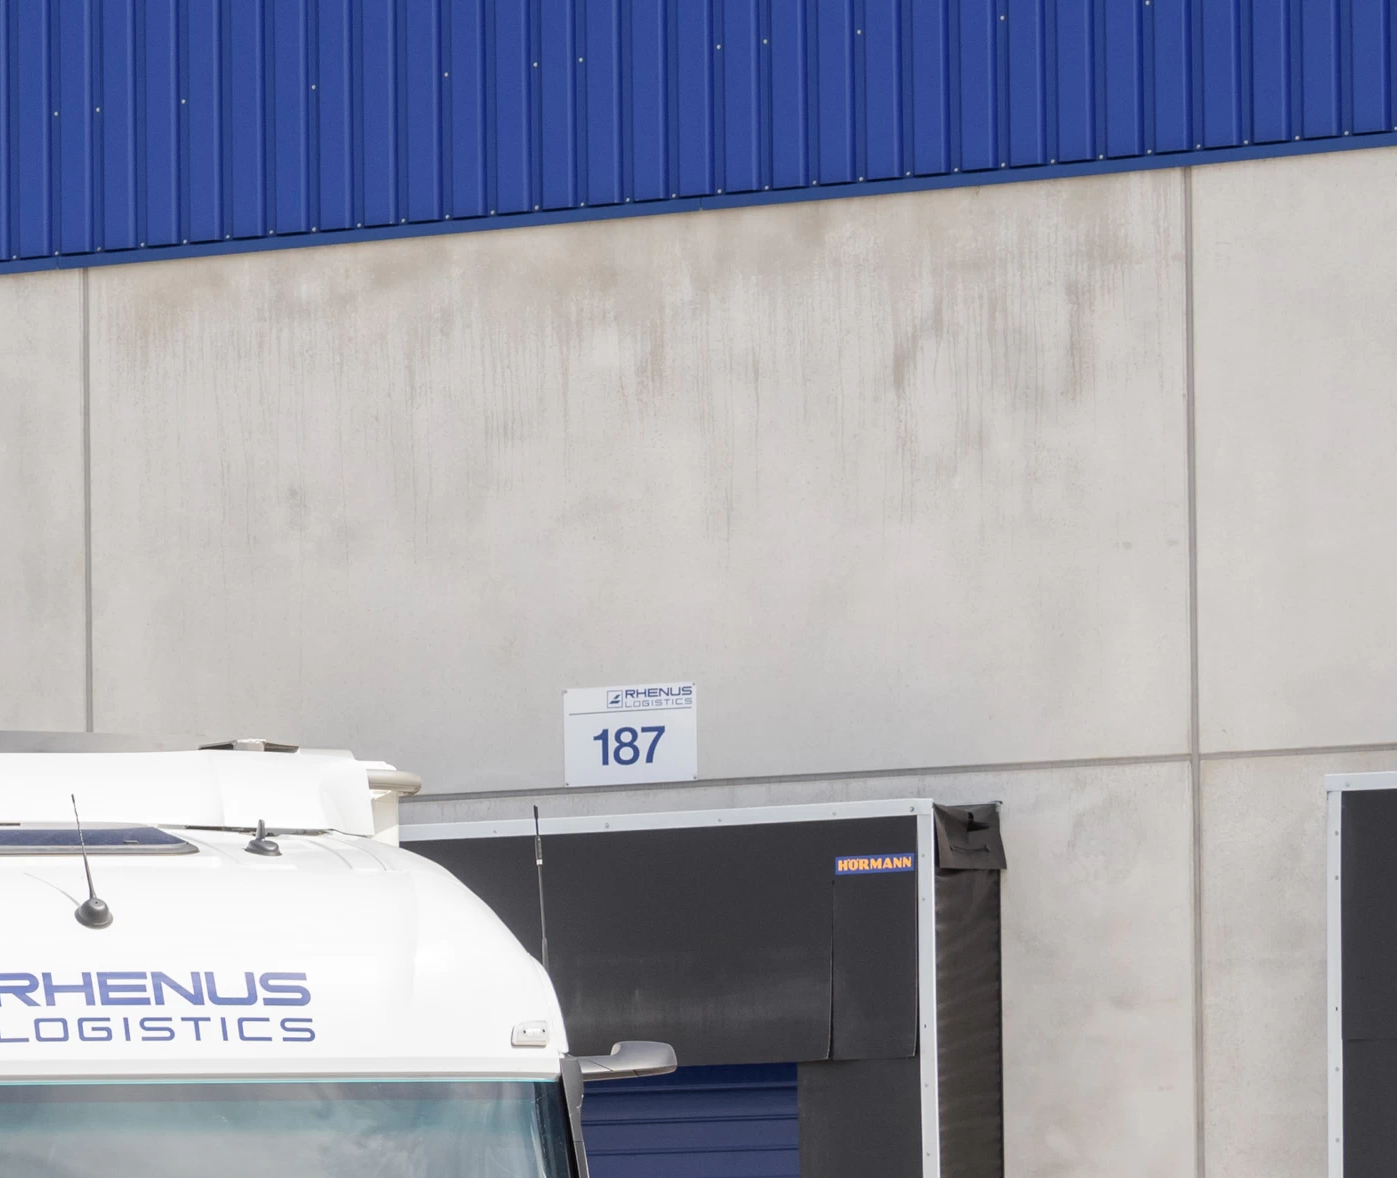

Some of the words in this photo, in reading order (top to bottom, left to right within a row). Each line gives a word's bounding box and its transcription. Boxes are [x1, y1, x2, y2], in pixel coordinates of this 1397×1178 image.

[624, 686, 693, 699] RHENUS
[624, 698, 693, 708] LOGISTICS
[592, 725, 666, 766] 187
